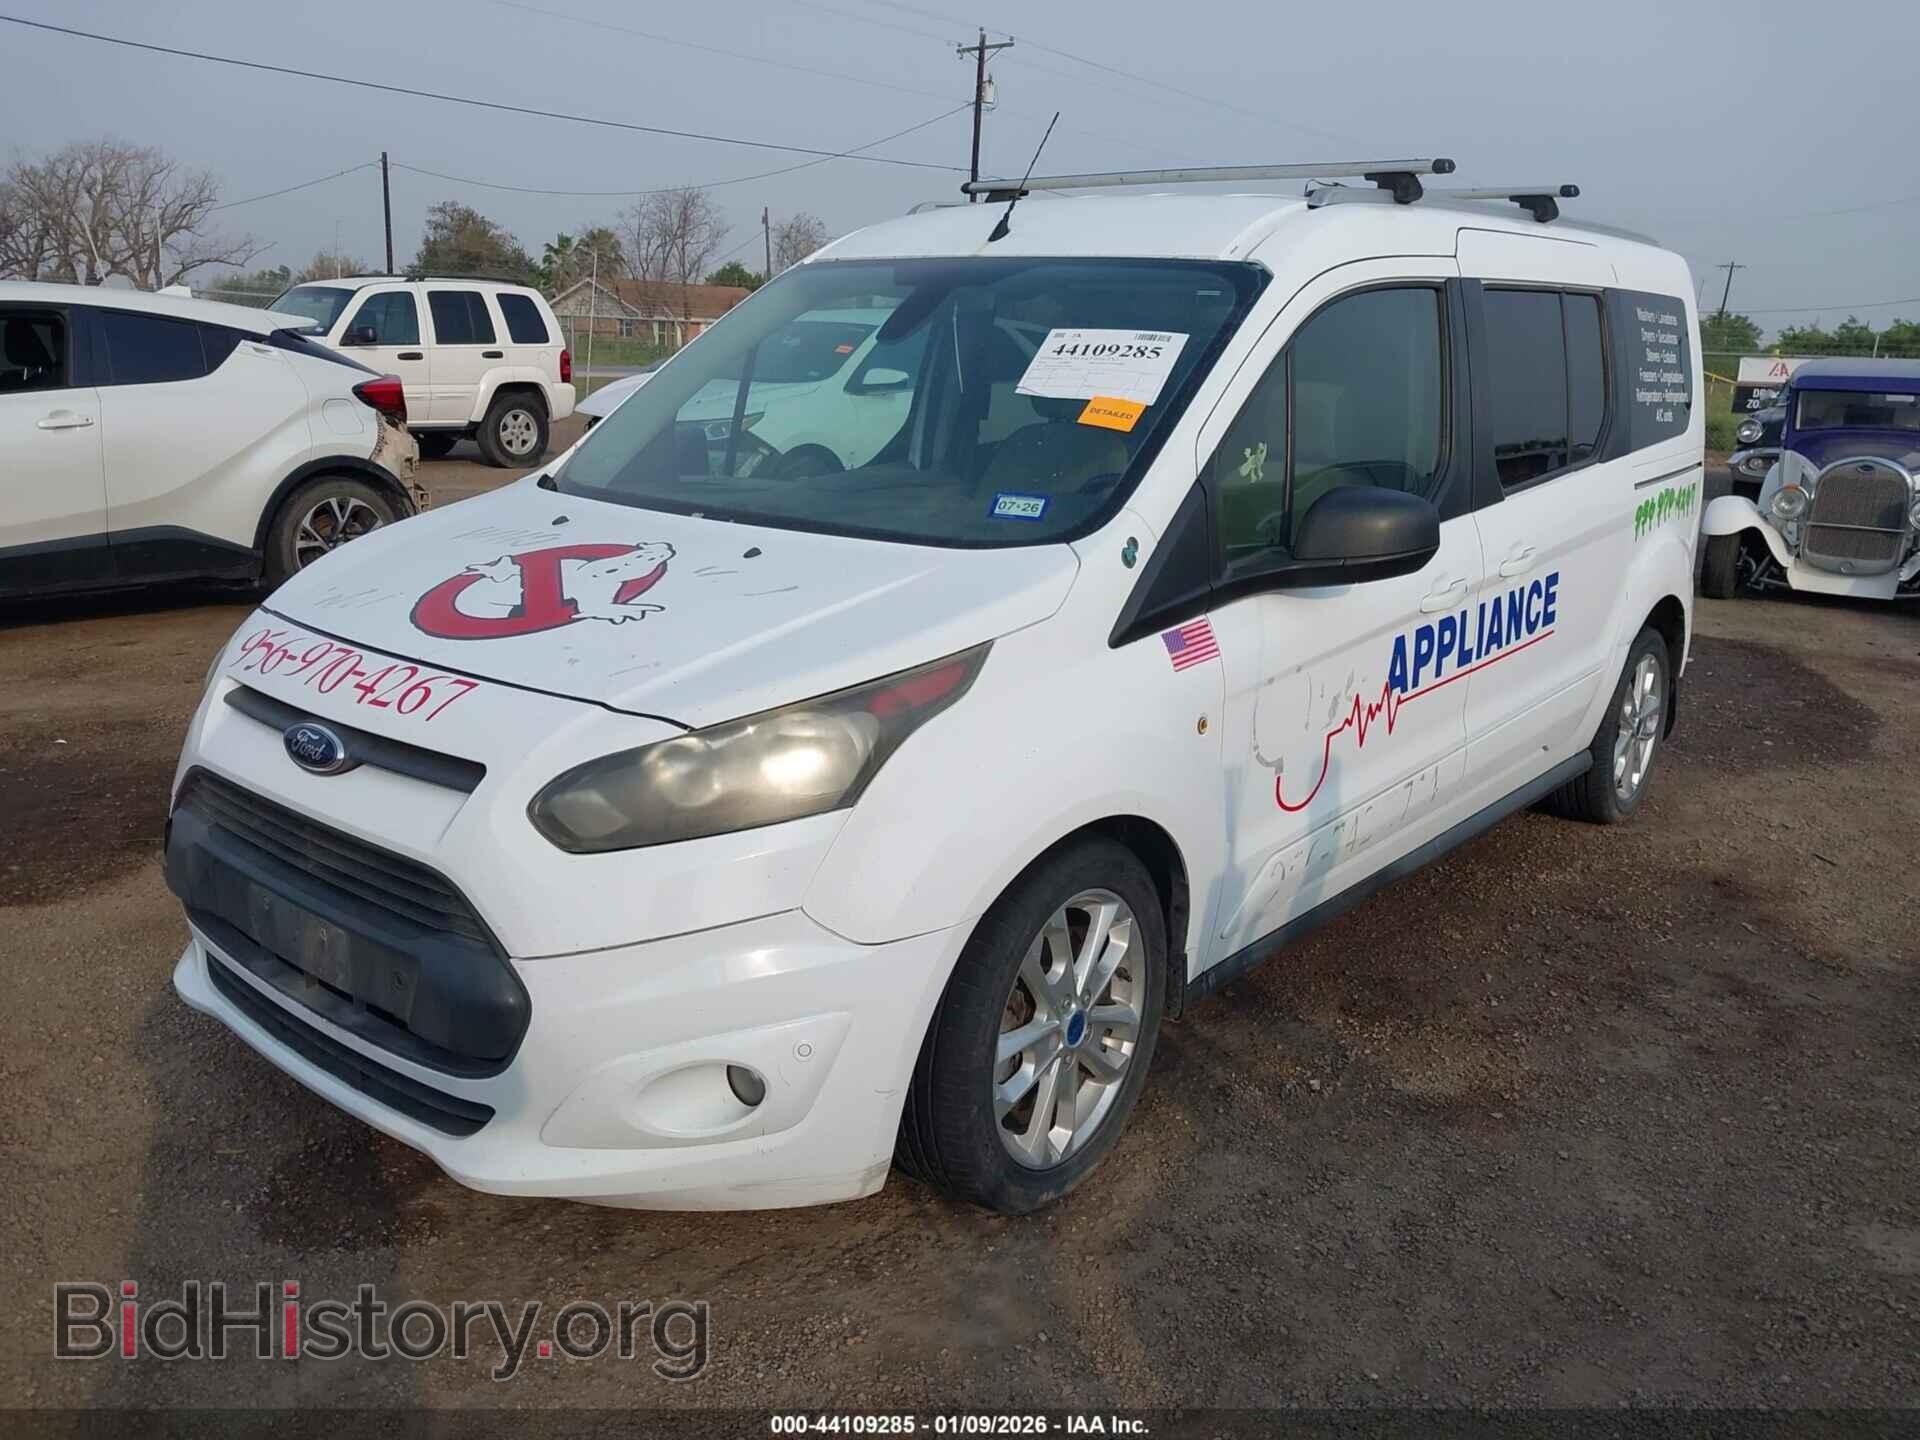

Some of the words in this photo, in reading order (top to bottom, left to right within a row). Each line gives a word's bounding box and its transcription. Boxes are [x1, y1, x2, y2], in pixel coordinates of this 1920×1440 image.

[1052, 343, 1164, 360] 44109285
[1090, 407, 1133, 420] DETAILED
[1388, 572, 1560, 694] APPLIANCE
[230, 628, 480, 722] 956-970-4267
[290, 729, 327, 761] Ford
